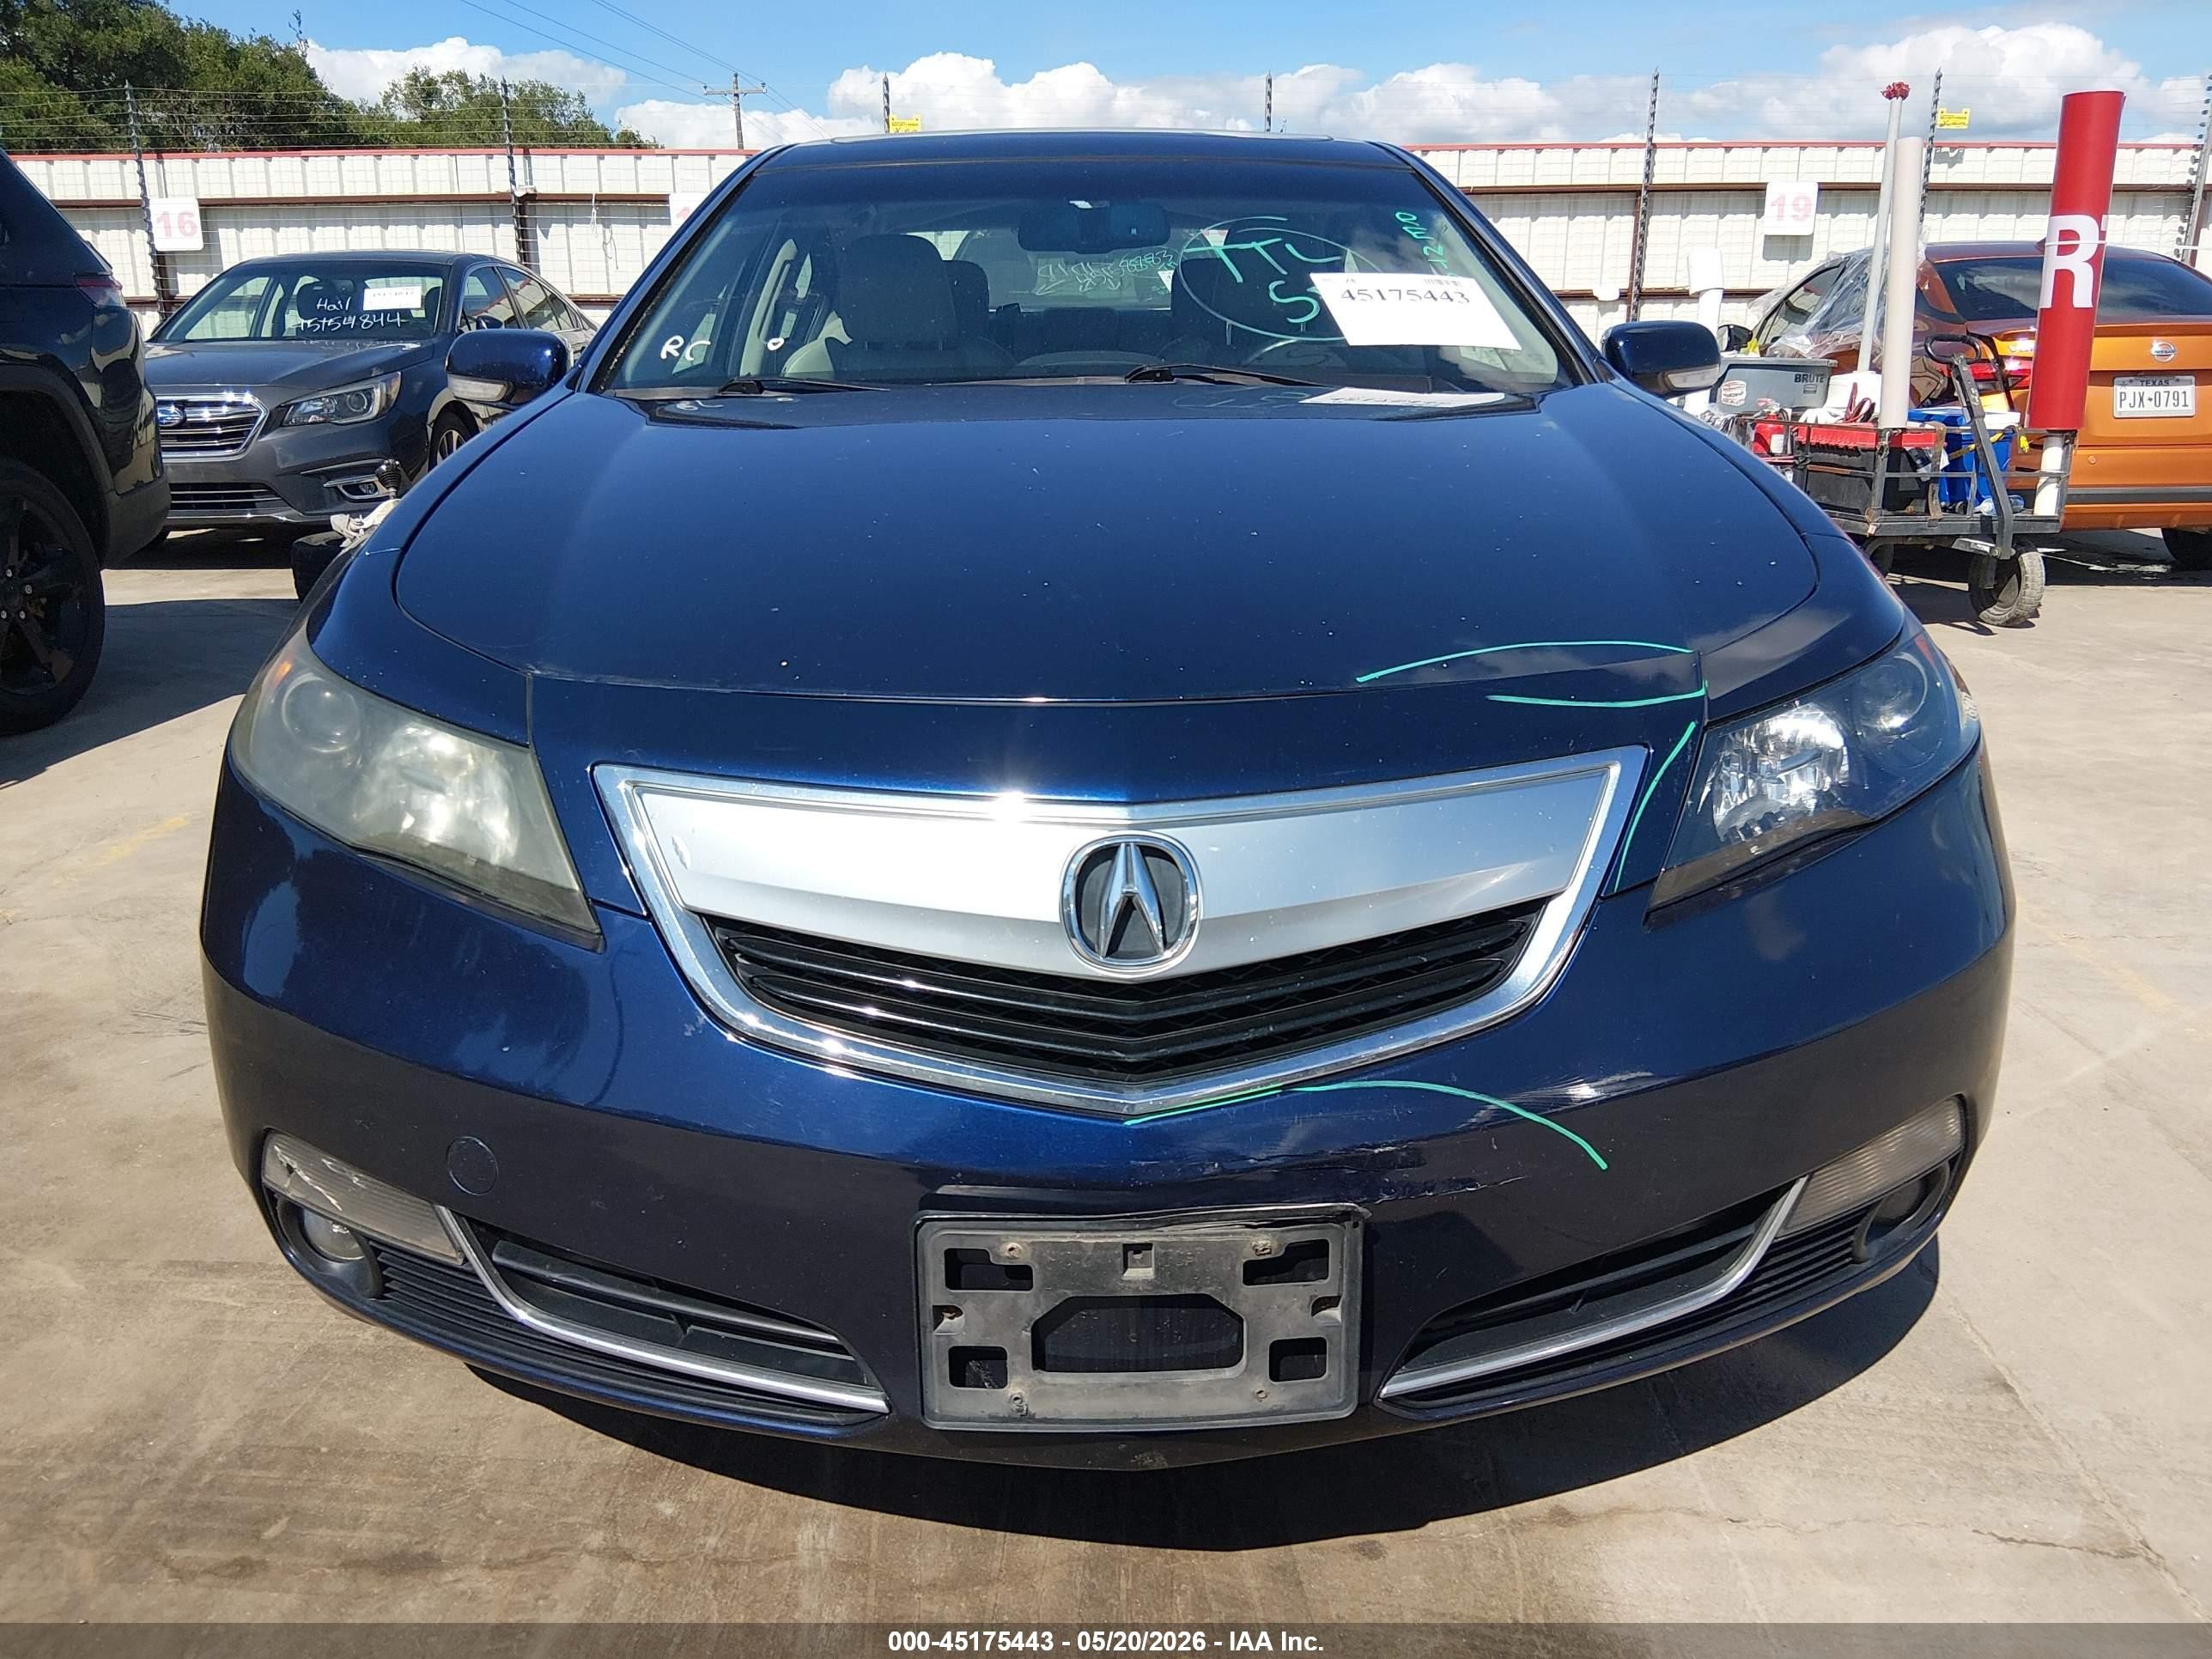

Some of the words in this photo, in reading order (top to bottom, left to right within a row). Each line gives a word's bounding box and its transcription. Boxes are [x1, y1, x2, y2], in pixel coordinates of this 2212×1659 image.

[1771, 193, 1813, 222] 19
[156, 211, 198, 238] 16
[2040, 215, 2109, 308] R
[316, 297, 351, 312] Hail
[1340, 289, 1470, 303] 45175443
[659, 335, 711, 361] RC
[1794, 374, 1826, 384] BRUTE
[2139, 379, 2170, 387] TEXAS
